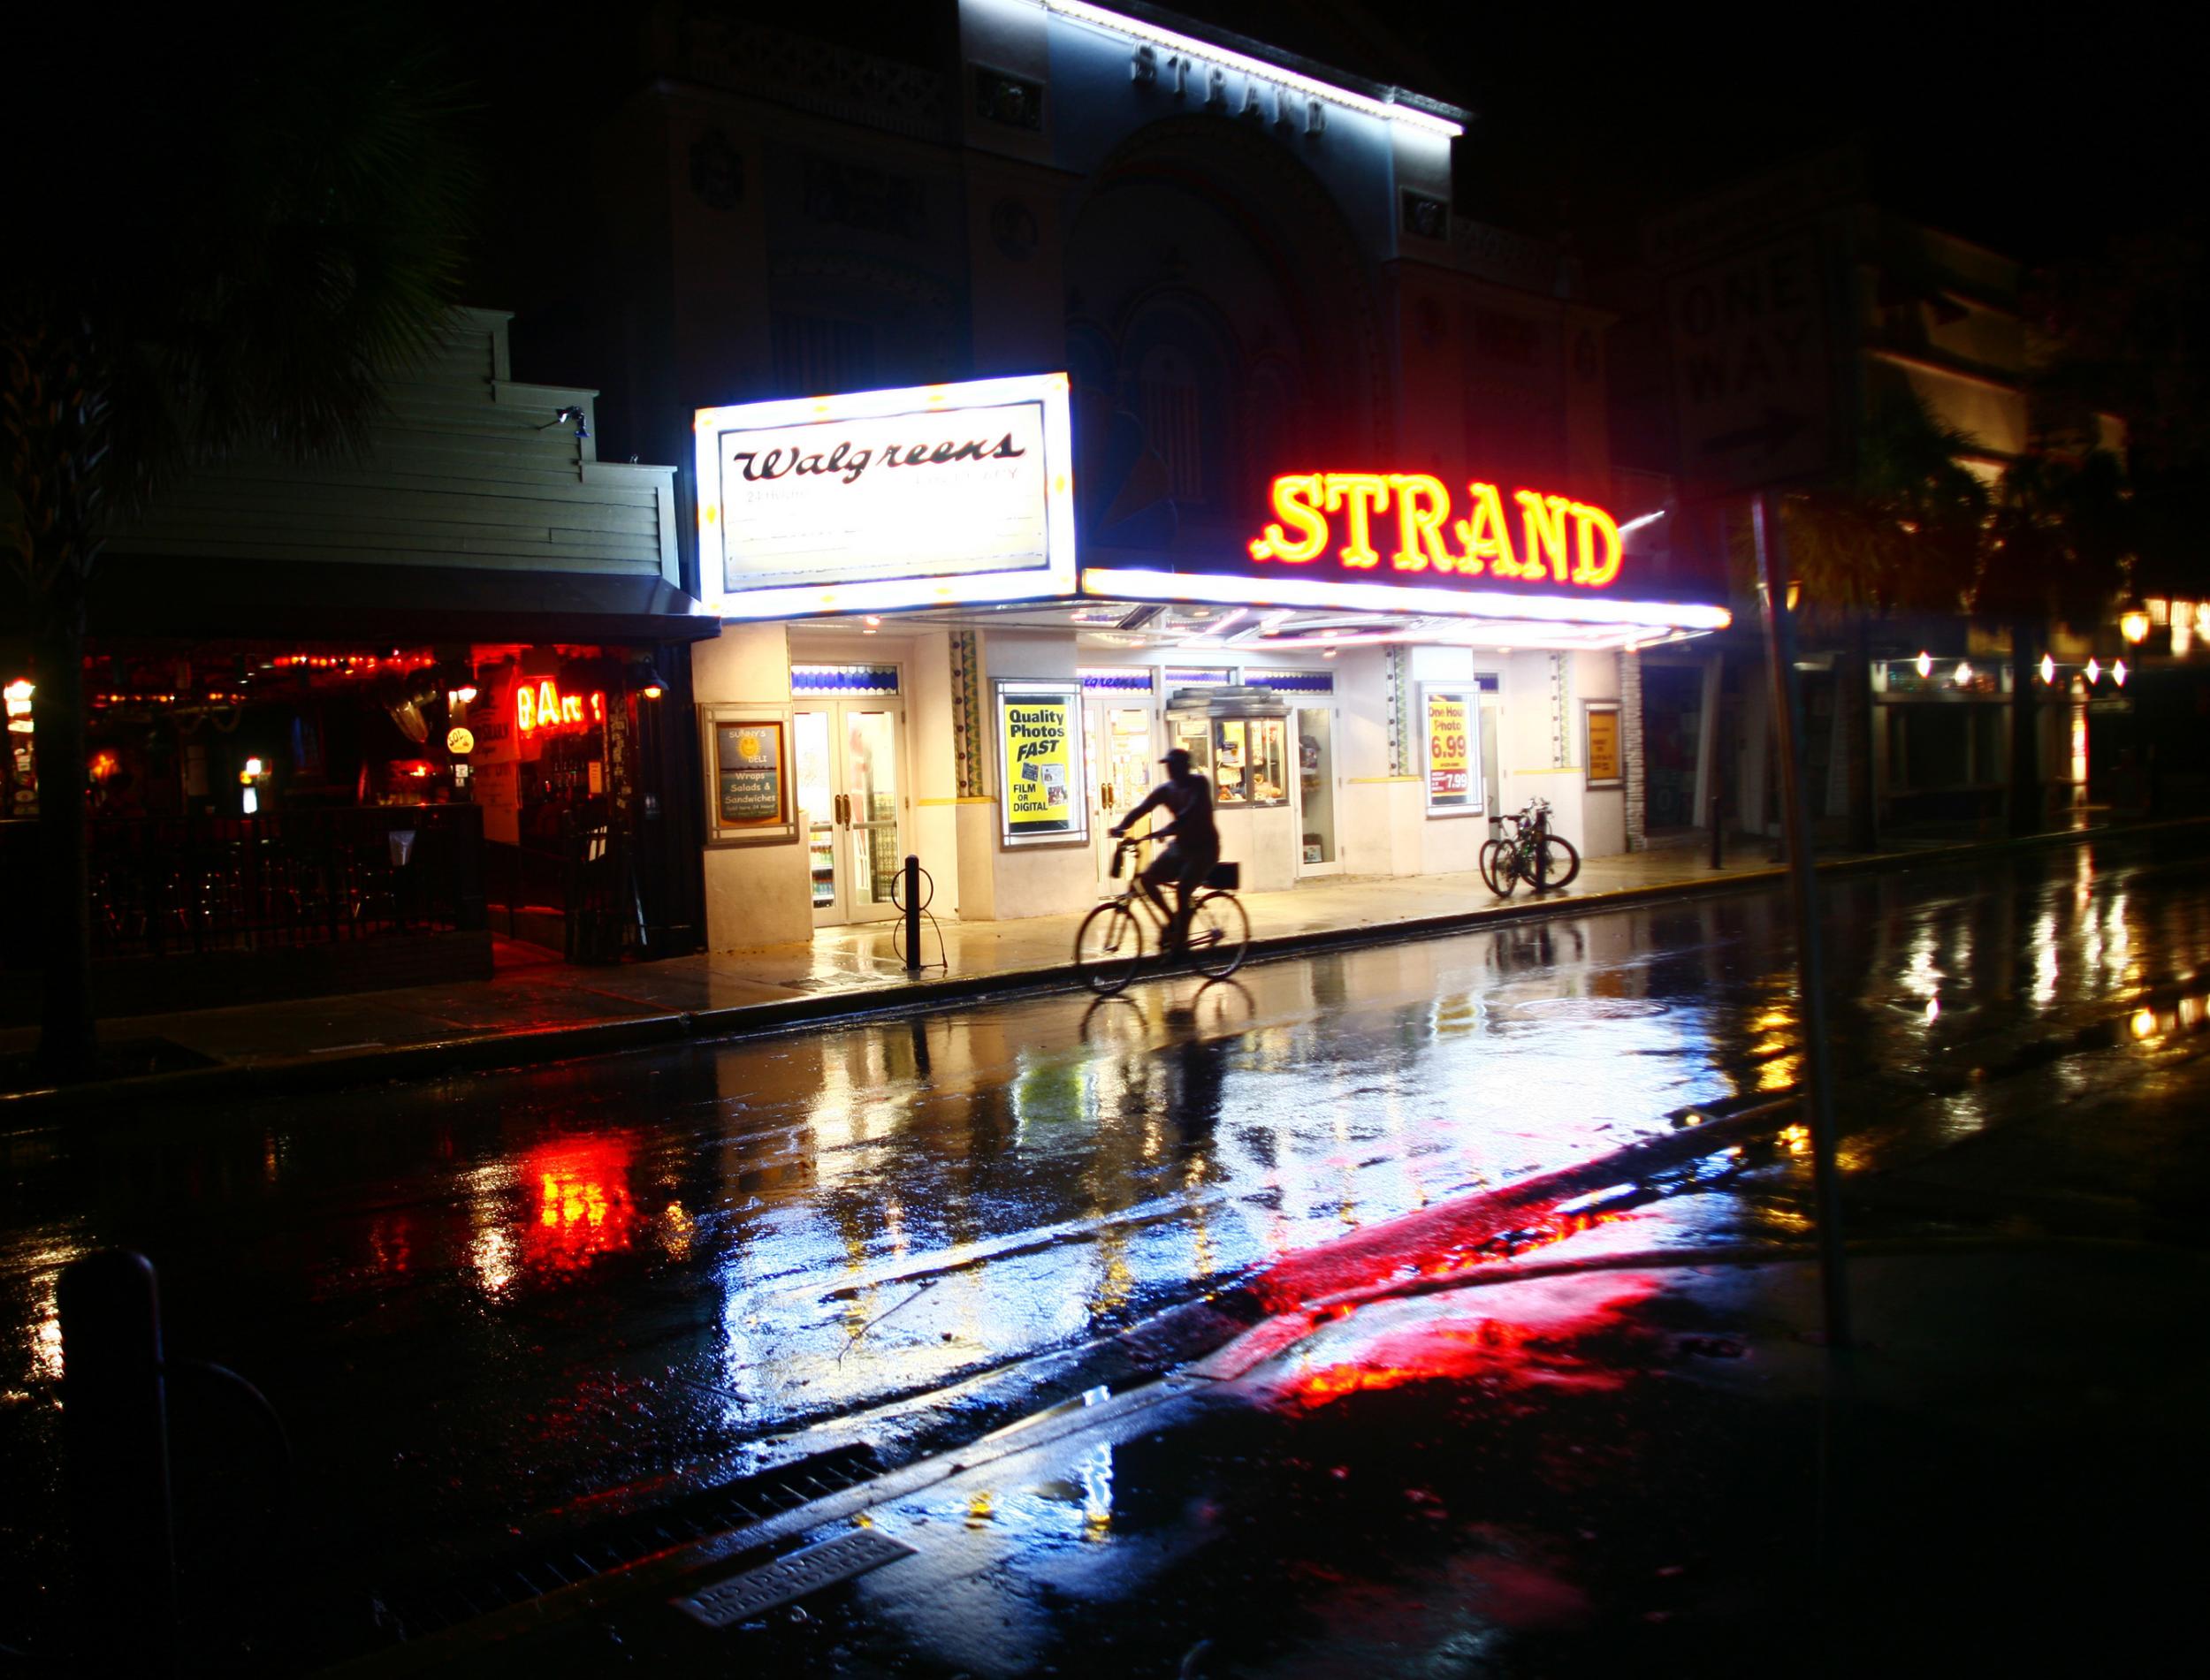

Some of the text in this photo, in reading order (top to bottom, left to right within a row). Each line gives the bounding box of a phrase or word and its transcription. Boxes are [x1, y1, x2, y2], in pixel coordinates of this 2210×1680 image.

[1131, 41, 1327, 134] STRAND
[1683, 251, 1806, 338] ONE
[1688, 321, 1812, 405] WAY
[734, 432, 1025, 484] Walgreens
[1249, 473, 1623, 586] STRAND
[1084, 675, 1137, 690] lgreens
[1010, 710, 1063, 725] Quality
[1446, 706, 1465, 717] Hou
[1010, 725, 1064, 737] Photos
[1434, 719, 1461, 731] Photo
[729, 729, 766, 738] SUNNY'S
[1017, 740, 1060, 763] FAST
[1432, 735, 1466, 758] 6.99
[735, 772, 765, 780] Wraps
[1447, 773, 1467, 788] 7.99
[730, 781, 771, 792] Salads &
[1013, 783, 1035, 794] FILM
[725, 794, 776, 804] Sandwiches
[1013, 802, 1048, 812] DIGITAL
